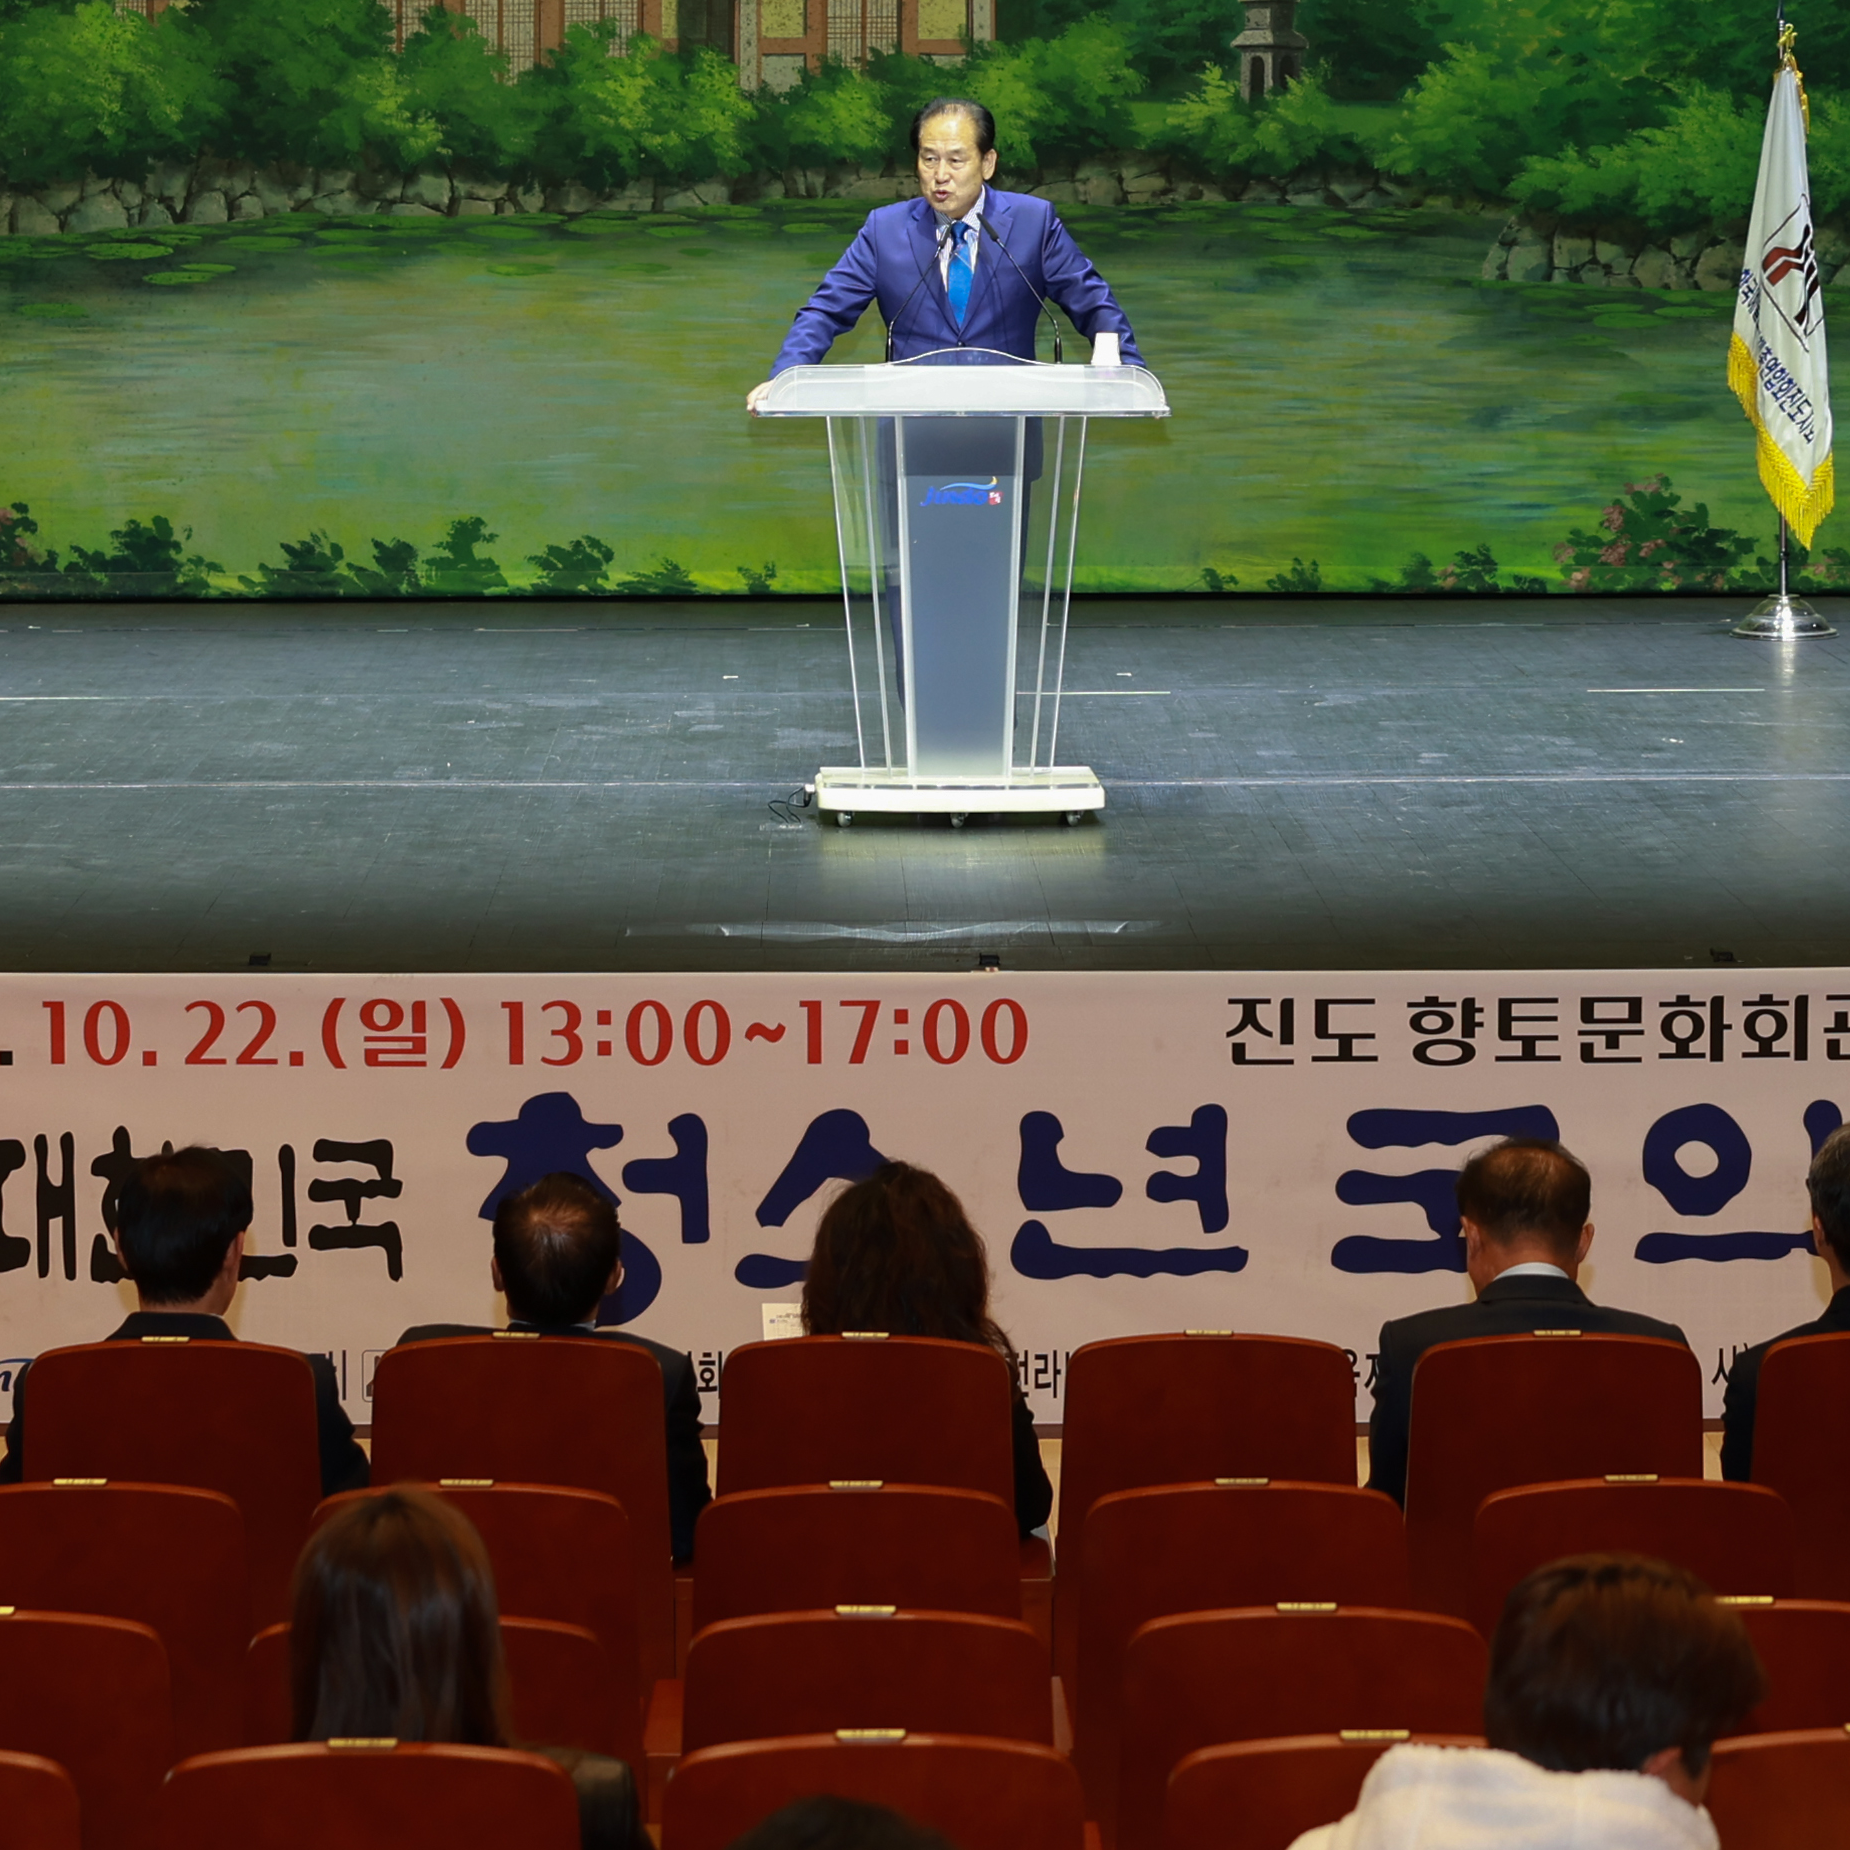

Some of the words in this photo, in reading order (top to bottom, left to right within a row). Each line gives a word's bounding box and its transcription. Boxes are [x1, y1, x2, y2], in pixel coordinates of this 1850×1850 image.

[42, 1000, 157, 1066] 10.
[501, 998, 1028, 1066] 13:00~17:00
[1226, 997, 1379, 1066] 진도
